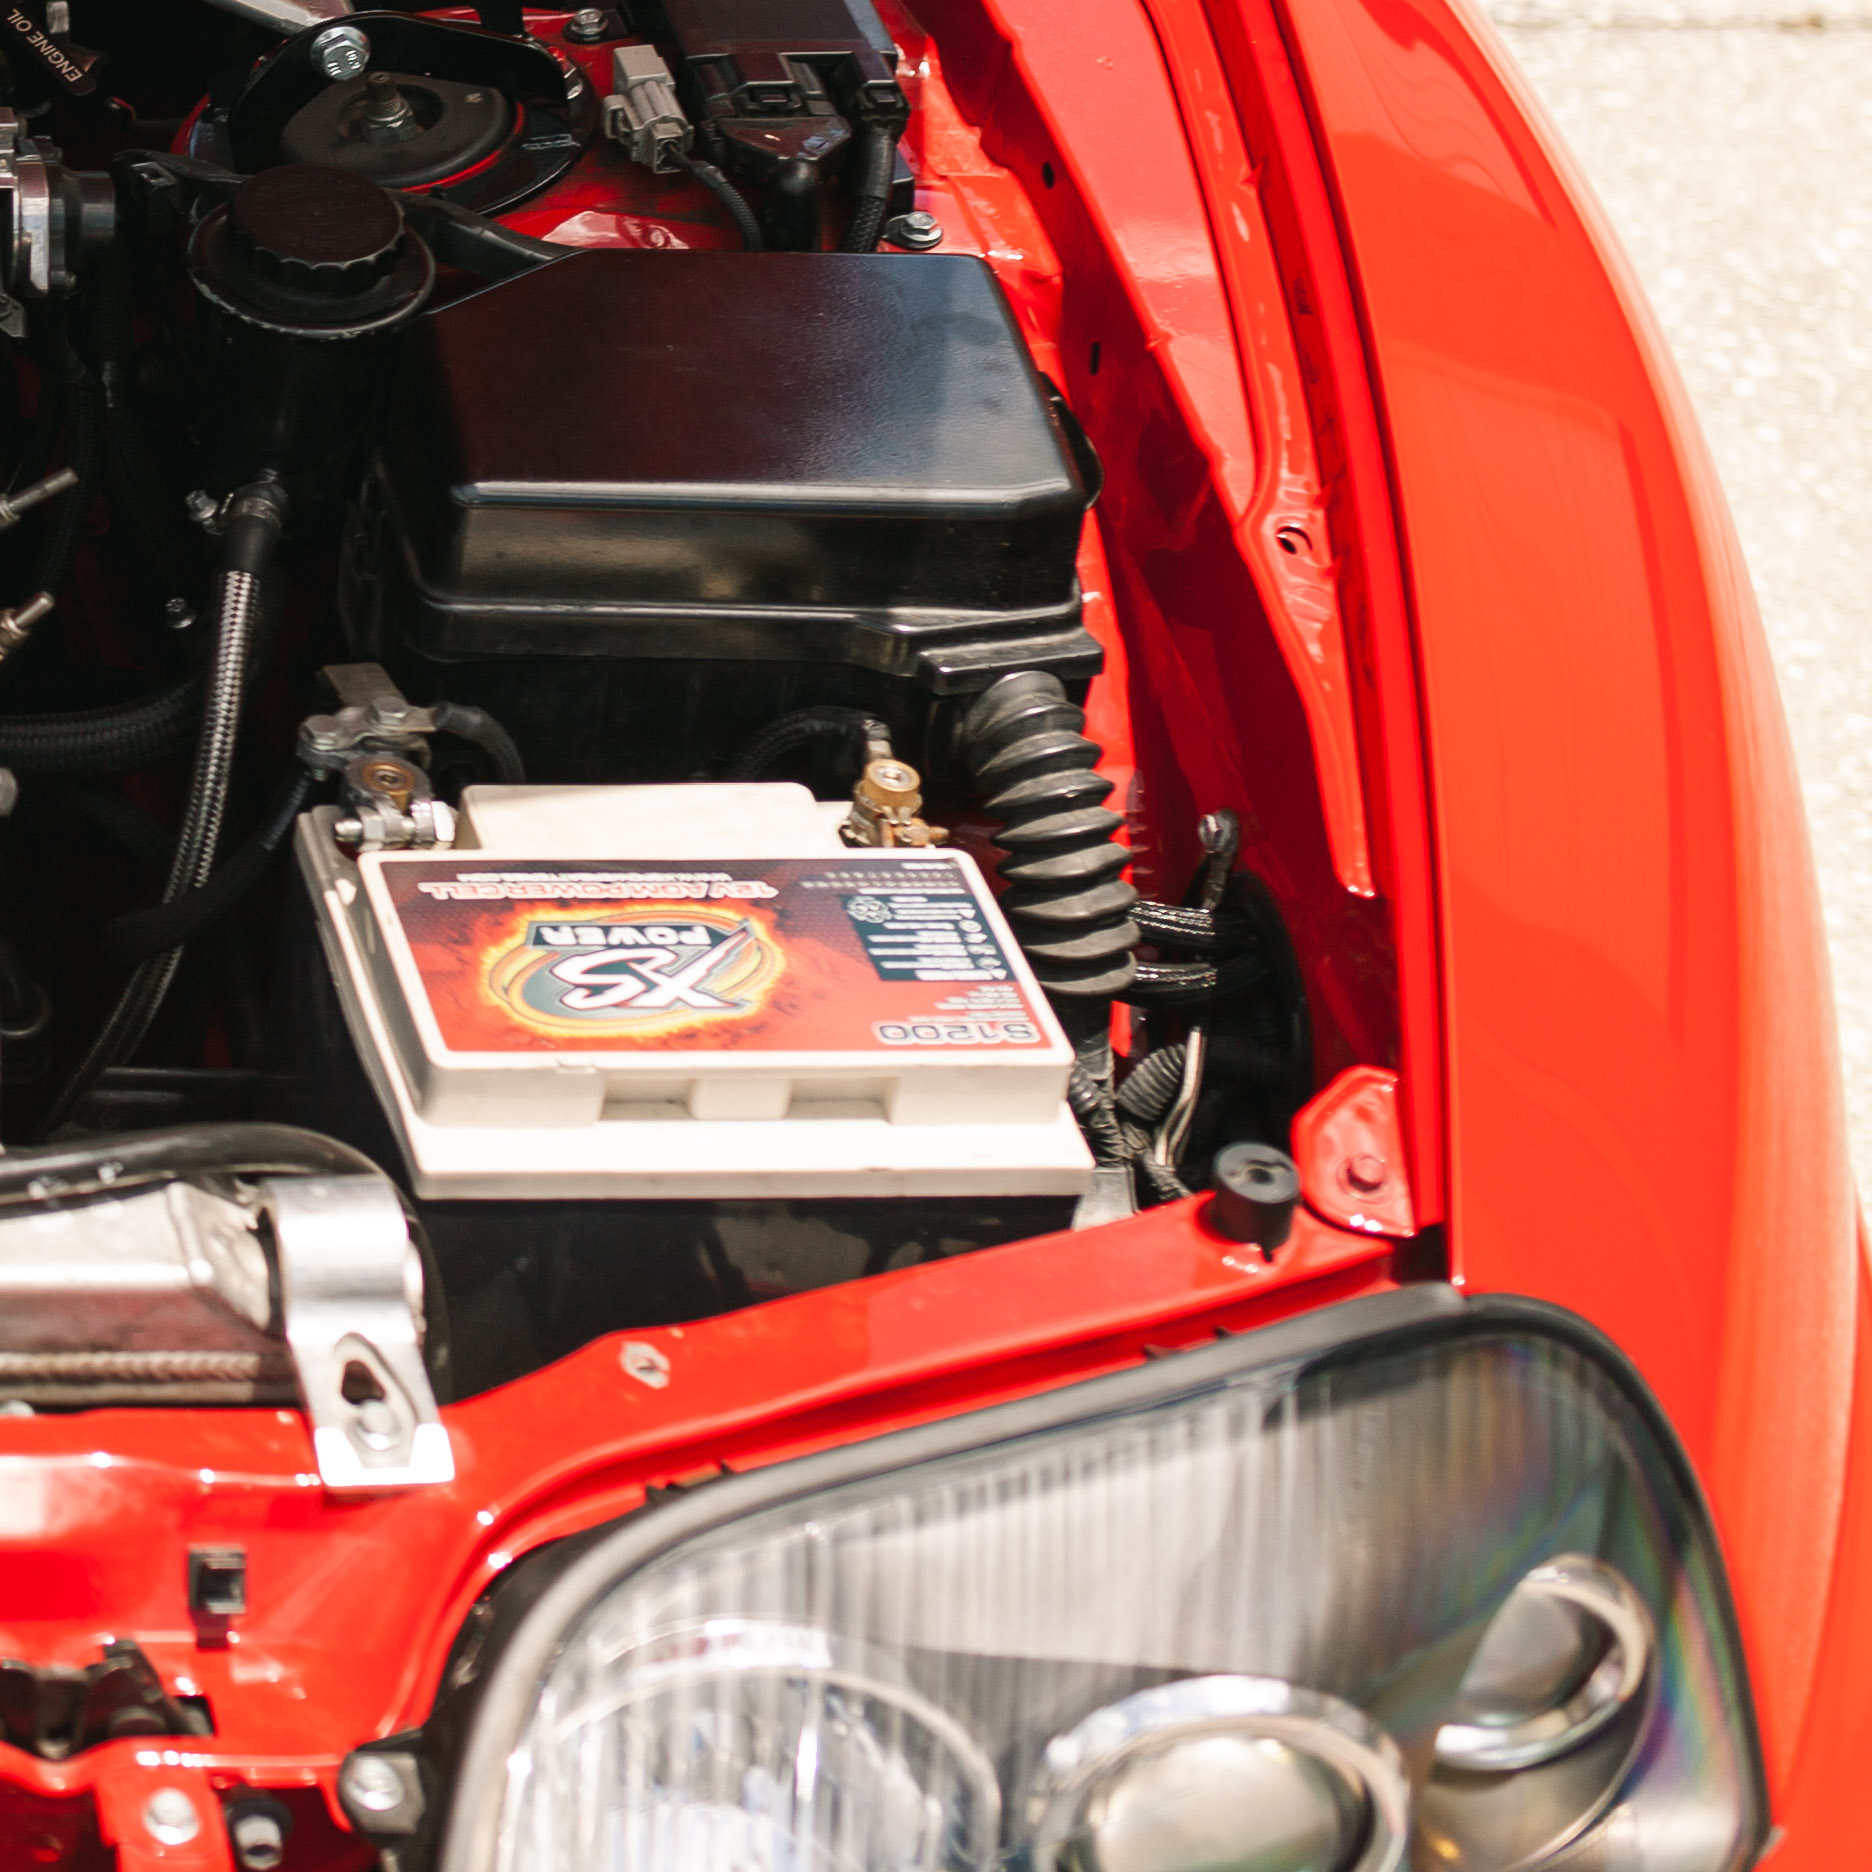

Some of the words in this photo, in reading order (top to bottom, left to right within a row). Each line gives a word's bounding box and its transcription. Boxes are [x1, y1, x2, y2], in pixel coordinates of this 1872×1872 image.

[6, 8, 33, 32] OIL
[26, 30, 83, 83] ENGINE
[417, 881, 506, 900] CELL
[507, 881, 627, 899] POWER
[710, 881, 779, 899] 12V
[539, 925, 712, 946] POWER
[550, 930, 746, 1010] XS
[874, 1022, 1038, 1044] S1200
